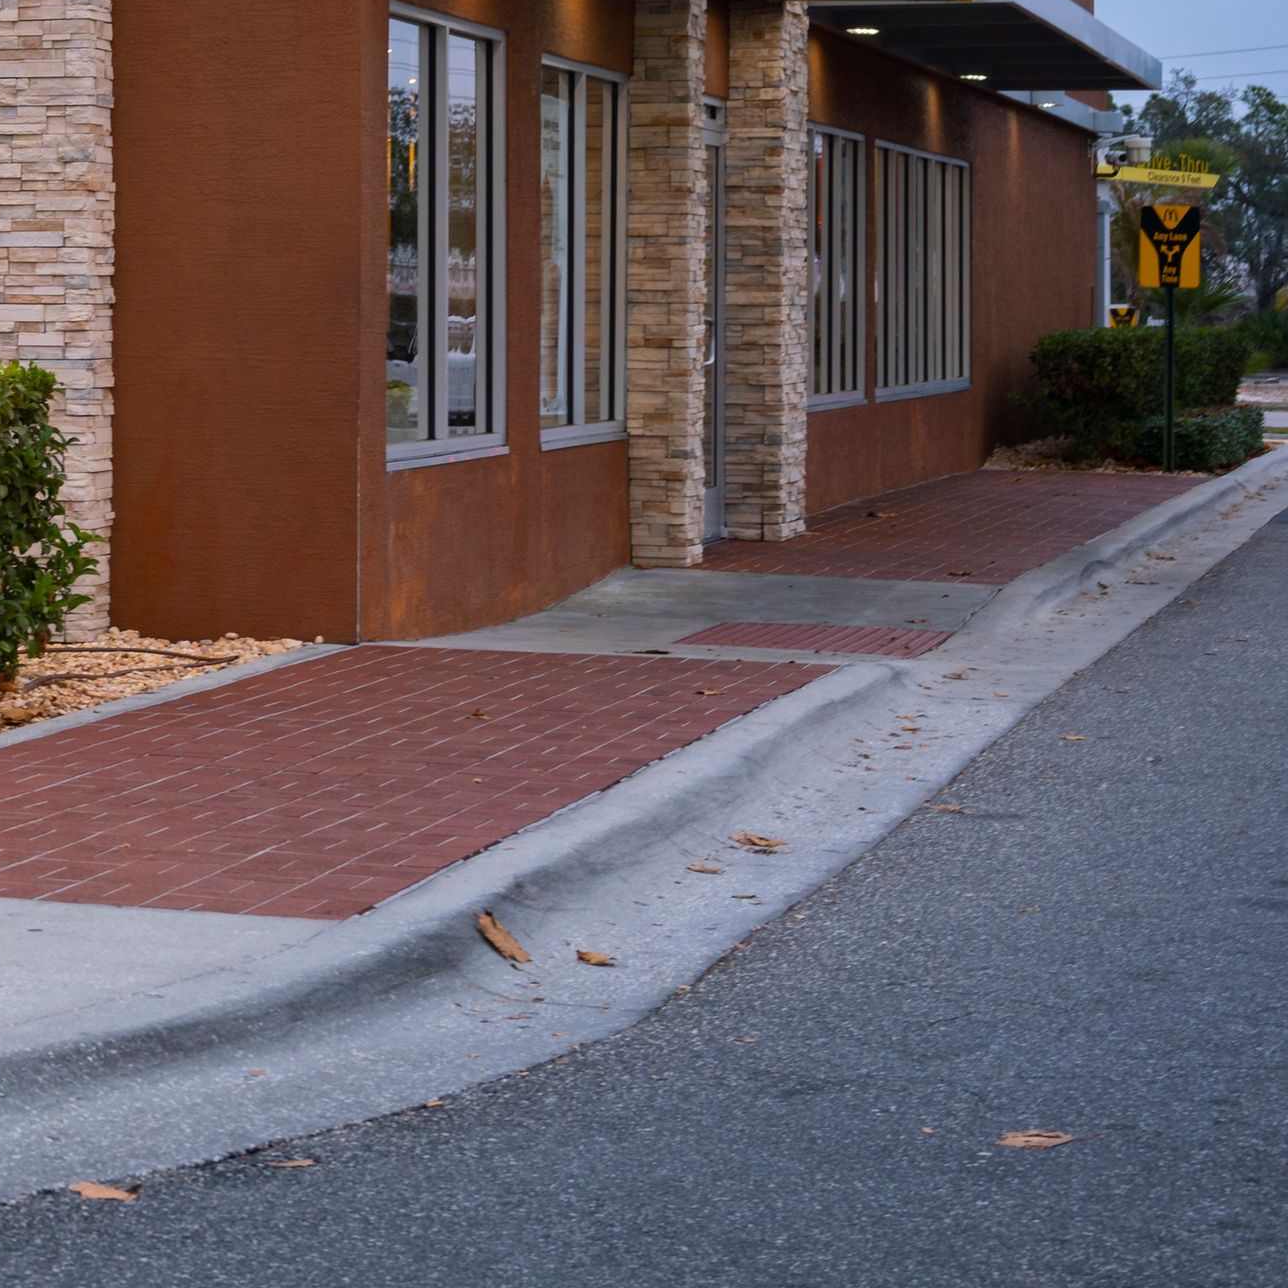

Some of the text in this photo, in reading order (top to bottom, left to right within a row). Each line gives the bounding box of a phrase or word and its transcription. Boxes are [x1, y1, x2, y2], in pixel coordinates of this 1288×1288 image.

[1135, 152, 1209, 174] ive-Thru
[1147, 171, 1180, 183] Clearance
[1187, 174, 1201, 184] Feet
[1153, 231, 1188, 242] Any Lane
[1162, 265, 1177, 275] Any
